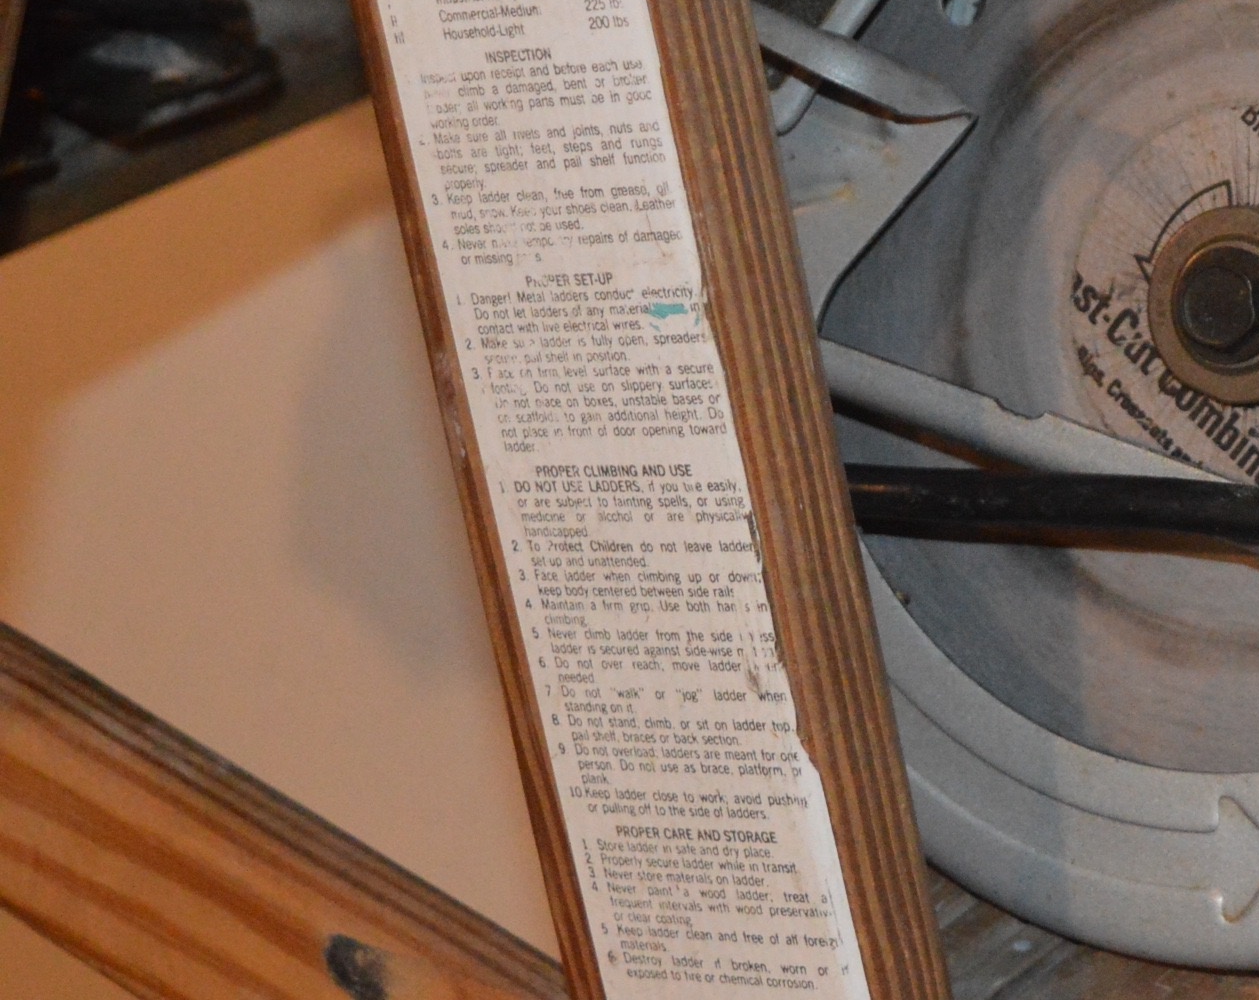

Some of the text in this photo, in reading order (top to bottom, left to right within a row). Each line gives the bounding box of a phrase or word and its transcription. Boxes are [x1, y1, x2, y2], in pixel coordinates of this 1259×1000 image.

[585, 0, 606, 11] 225
[443, 24, 525, 40] Household-Light
[589, 17, 610, 30] 200
[485, 48, 551, 64] INSPECTION
[461, 69, 486, 82] upon
[530, 65, 549, 76] and
[458, 85, 484, 98] climb
[563, 79, 587, 90] bent
[467, 122, 633, 142] sure and nuts
[563, 137, 662, 153] steps and rungs
[484, 151, 665, 172] spreader and shelf function
[479, 186, 604, 202] ladder from
[566, 202, 597, 214] shoes
[578, 232, 613, 244] repairs
[474, 253, 513, 265] missing
[574, 273, 613, 286] SET-UP
[493, 305, 568, 319] not ladders
[517, 318, 609, 333] with electrical
[540, 336, 571, 348] ladder
[592, 363, 714, 376] surface with secure
[555, 379, 661, 392] not slippery
[622, 392, 703, 405] unstable bases
[608, 409, 658, 422] additional
[614, 424, 727, 438] door opening toward
[536, 464, 692, 477] PROPER CLIMBING AND USE
[536, 481, 557, 493] NOT
[715, 496, 745, 509] using
[521, 511, 565, 522] medicine
[590, 540, 712, 552] Children not leave
[535, 570, 681, 584] Face ladder when climbing
[538, 585, 709, 598] keep body centered between side
[542, 599, 710, 612] Maintain firm Use both
[549, 628, 576, 640] Never
[585, 629, 610, 641] climb
[617, 630, 648, 641] ladder
[656, 630, 679, 642] from
[711, 631, 732, 642] side
[551, 643, 581, 654] ladder
[600, 643, 639, 656] secured
[644, 644, 679, 657] against
[686, 645, 732, 657] side-wise
[577, 658, 593, 669] not
[602, 660, 622, 669] over
[673, 660, 699, 671] move
[709, 660, 741, 672] ladder
[713, 690, 787, 702] ladder when
[564, 700, 607, 712] standing
[587, 716, 766, 731] not on ladder
[623, 732, 698, 745] braces back
[661, 747, 757, 761] ladders meant
[661, 762, 678, 772] use
[615, 788, 762, 805] ladder close avoid
[603, 803, 710, 818] pulling the side
[616, 825, 778, 844] PROPER CARE AND STORAGE
[597, 839, 739, 859] Store dry
[601, 854, 714, 869] Properly secure ladder
[604, 868, 728, 884] Never store materials on
[608, 882, 809, 903] Never paint wood treat
[609, 895, 762, 915] frequent intervals with wood
[617, 924, 763, 943] Keep ladder clean and free
[623, 951, 807, 974] Destroy ladder worn
[627, 968, 763, 986] exposed chemical
